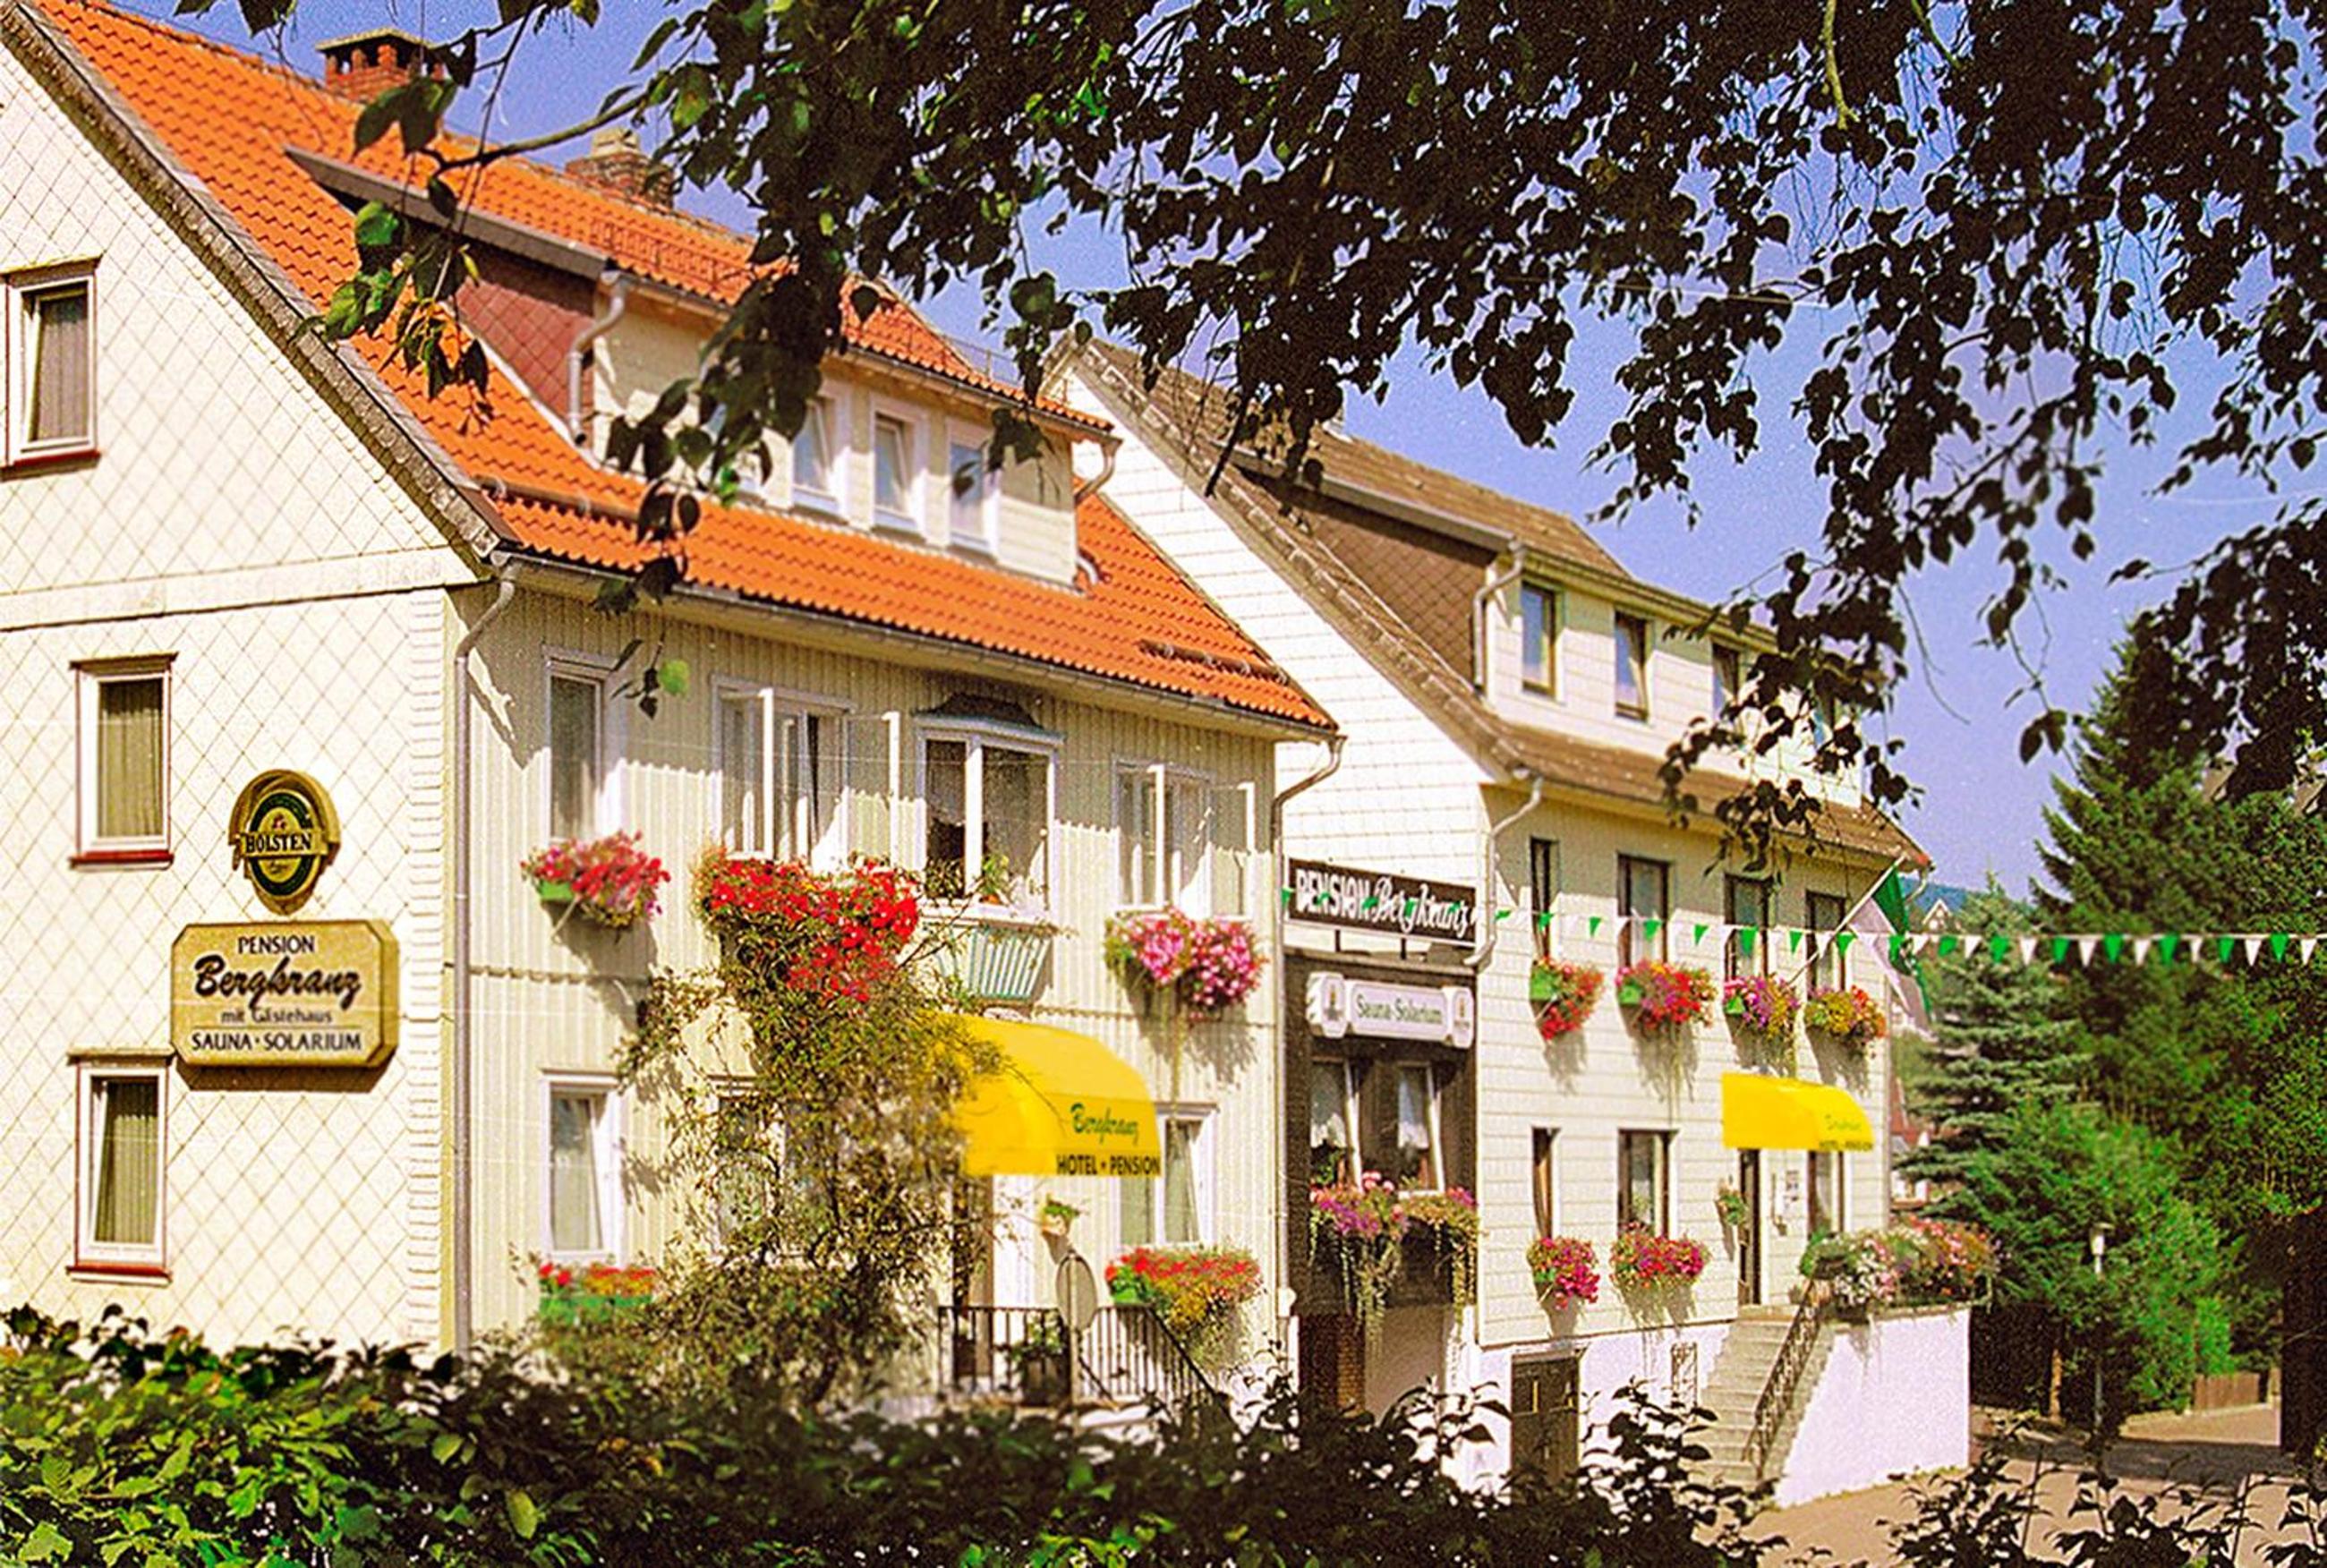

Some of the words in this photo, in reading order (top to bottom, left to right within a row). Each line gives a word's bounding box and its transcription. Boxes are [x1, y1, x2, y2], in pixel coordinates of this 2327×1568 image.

[243, 831, 312, 854] HOLSTEN
[1295, 868, 1370, 921] PENSION
[238, 934, 315, 954] PENSION
[194, 954, 362, 1011] Bergkranz
[221, 1008, 245, 1024] mit
[251, 1007, 333, 1024] Gästehaus
[192, 1032, 252, 1051] SAUNA
[263, 1032, 362, 1051] SOLARIUM
[1056, 1154, 1097, 1175] HOTEL
[1110, 1155, 1161, 1176] PENSION
